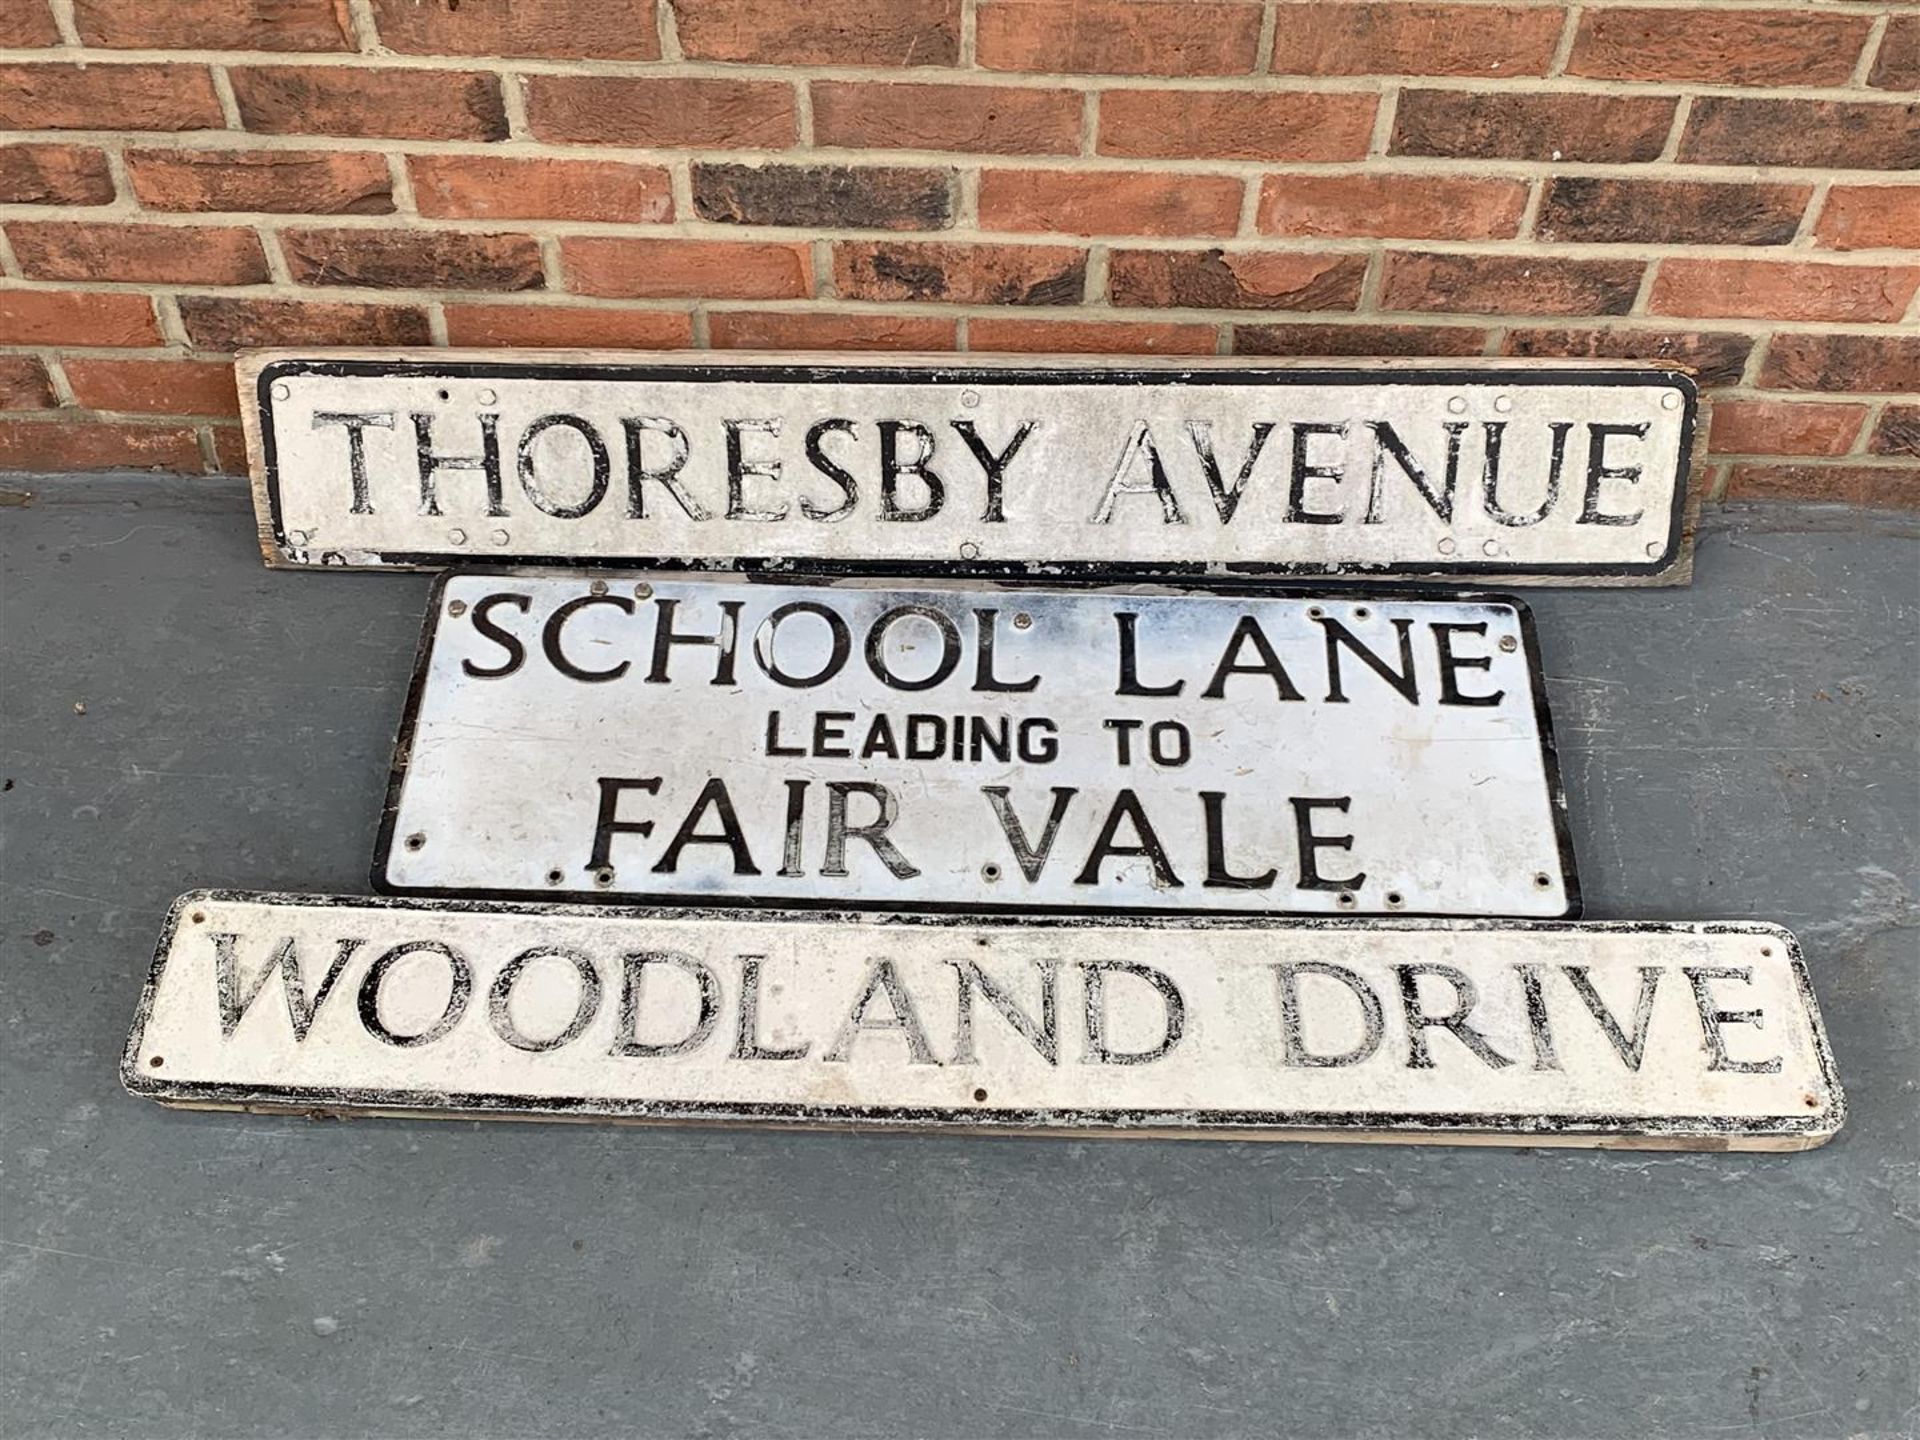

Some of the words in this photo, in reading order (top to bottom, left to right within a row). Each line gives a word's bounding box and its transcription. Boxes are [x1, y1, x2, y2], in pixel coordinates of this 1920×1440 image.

[311, 411, 1038, 523] THORESBY
[1091, 420, 1652, 526] AVENUE
[461, 593, 1041, 692] SCHOOL
[1114, 611, 1505, 707] LANE
[764, 710, 1059, 764] LEADING
[1103, 718, 1191, 766] TO
[584, 776, 920, 879] FAIR
[981, 785, 1366, 890] VALE
[209, 934, 1186, 1067] WOODLAND
[1274, 962, 1784, 1075] DRIVE
